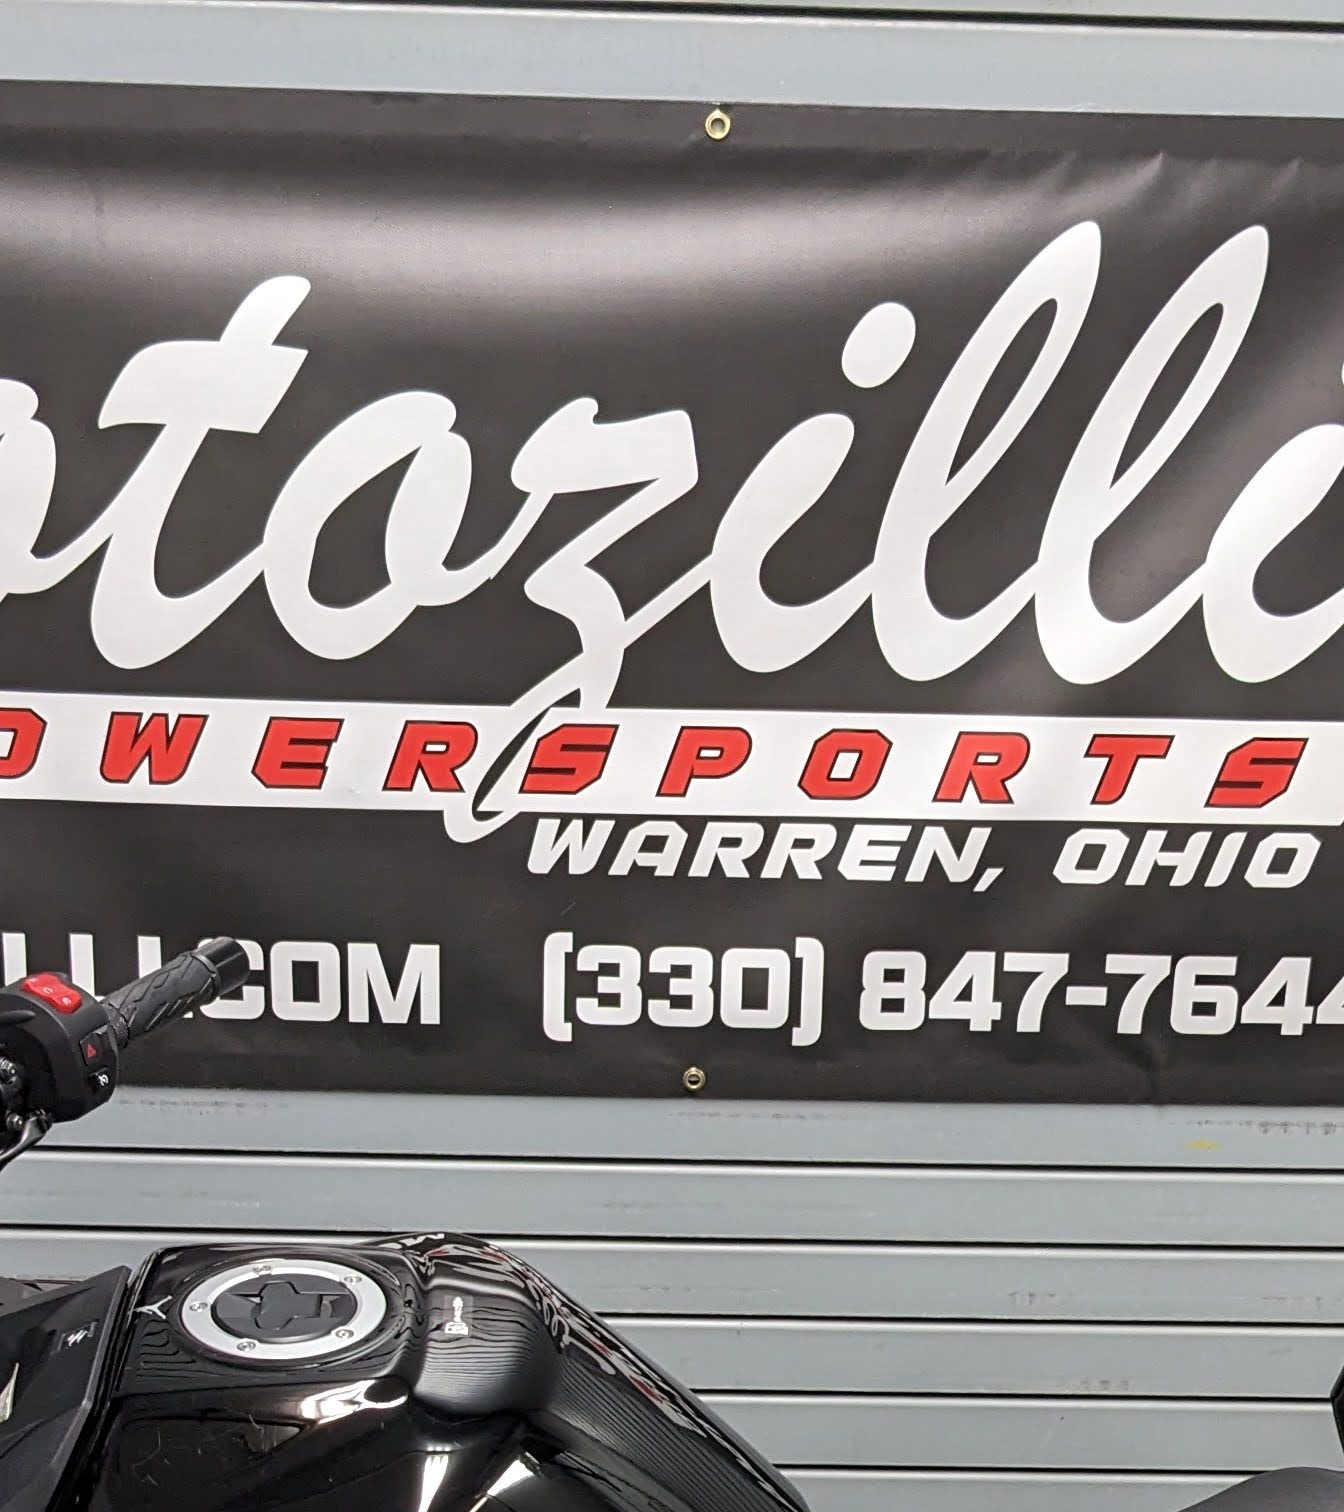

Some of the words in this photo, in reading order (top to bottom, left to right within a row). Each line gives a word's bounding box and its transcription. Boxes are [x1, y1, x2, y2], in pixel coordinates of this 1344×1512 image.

[527, 820, 1004, 892] WARREN,
[1052, 828, 1322, 889] OHIO
[542, 931, 825, 1047] (330)
